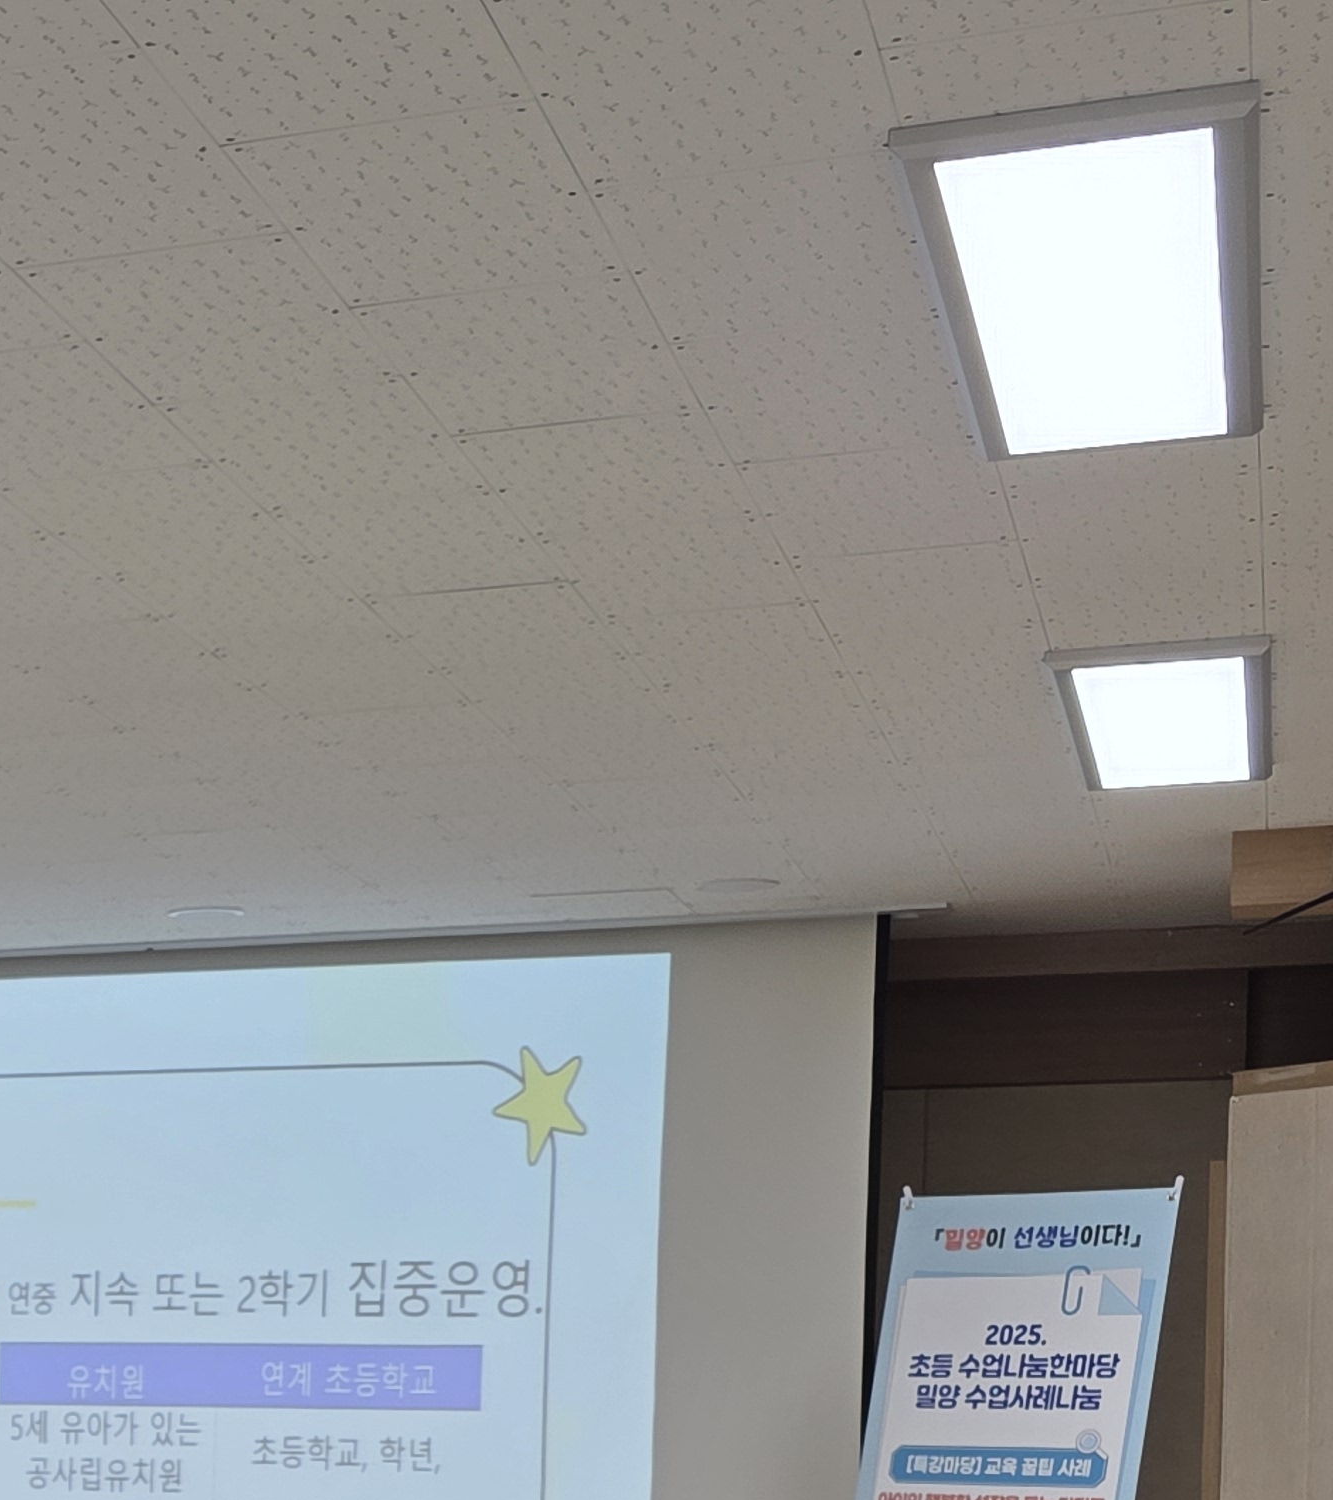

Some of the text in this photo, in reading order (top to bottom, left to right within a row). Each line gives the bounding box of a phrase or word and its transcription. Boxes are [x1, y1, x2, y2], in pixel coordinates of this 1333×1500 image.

[8, 1282, 58, 1317] 연중
[69, 1270, 140, 1317] 지속
[152, 1270, 225, 1317] 또는
[236, 1268, 331, 1317] 2학기
[348, 1257, 544, 1319] 집중운영.
[985, 1324, 1047, 1346] 2025.
[66, 1364, 146, 1399] 유치원
[260, 1361, 437, 1398] 연계 초등학교
[908, 1354, 1120, 1379] 초등 수업나눔한마당
[915, 1384, 1102, 1411] 밀양 수업사례나눔
[9, 1411, 202, 1448] 5세 유아가 있는
[252, 1436, 441, 1475] 초등학교, 학년,
[986, 1457, 1016, 1476] 교육
[1058, 1458, 1091, 1478] 사례
[25, 1458, 183, 1494] 공사립유치원
